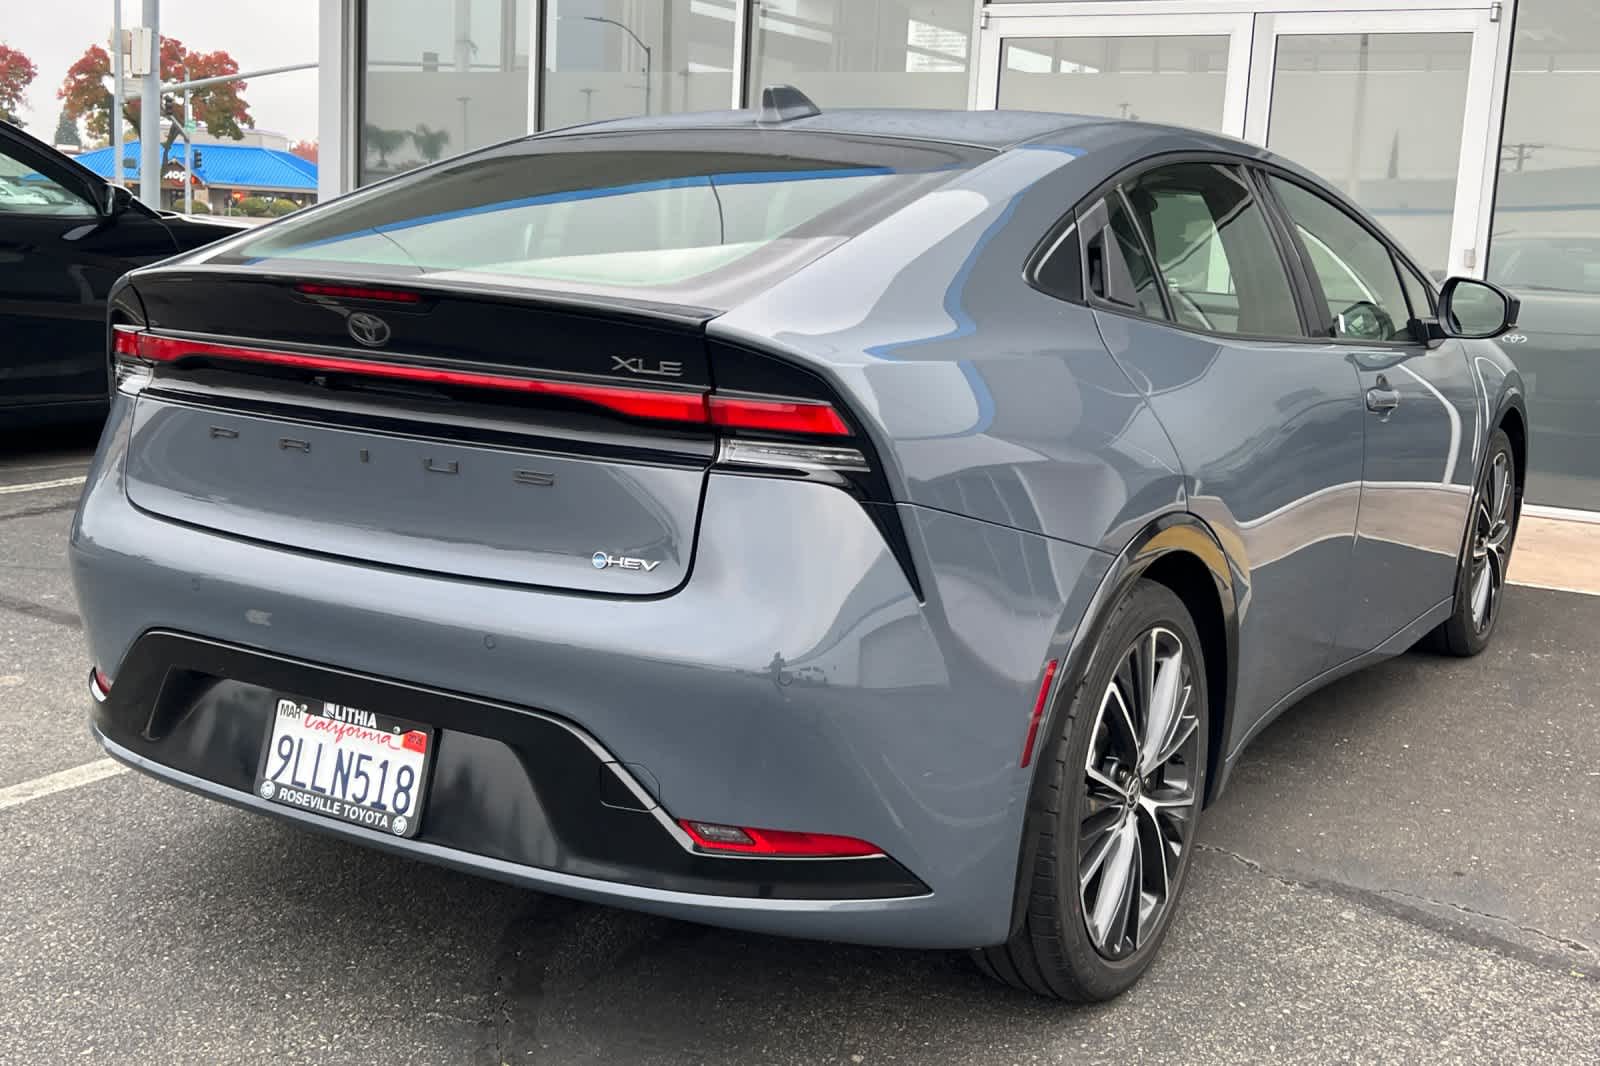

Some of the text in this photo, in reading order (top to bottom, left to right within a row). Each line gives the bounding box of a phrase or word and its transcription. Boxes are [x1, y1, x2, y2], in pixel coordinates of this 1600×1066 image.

[611, 355, 682, 377] XLE
[209, 426, 555, 486] PRIUS
[607, 555, 660, 572] HEV
[280, 703, 301, 720] MAR
[335, 706, 377, 729] LITHIA
[304, 713, 400, 750] California
[271, 734, 415, 815] 9LLN518
[279, 787, 389, 828] ROSEVILLE TOYOTA
